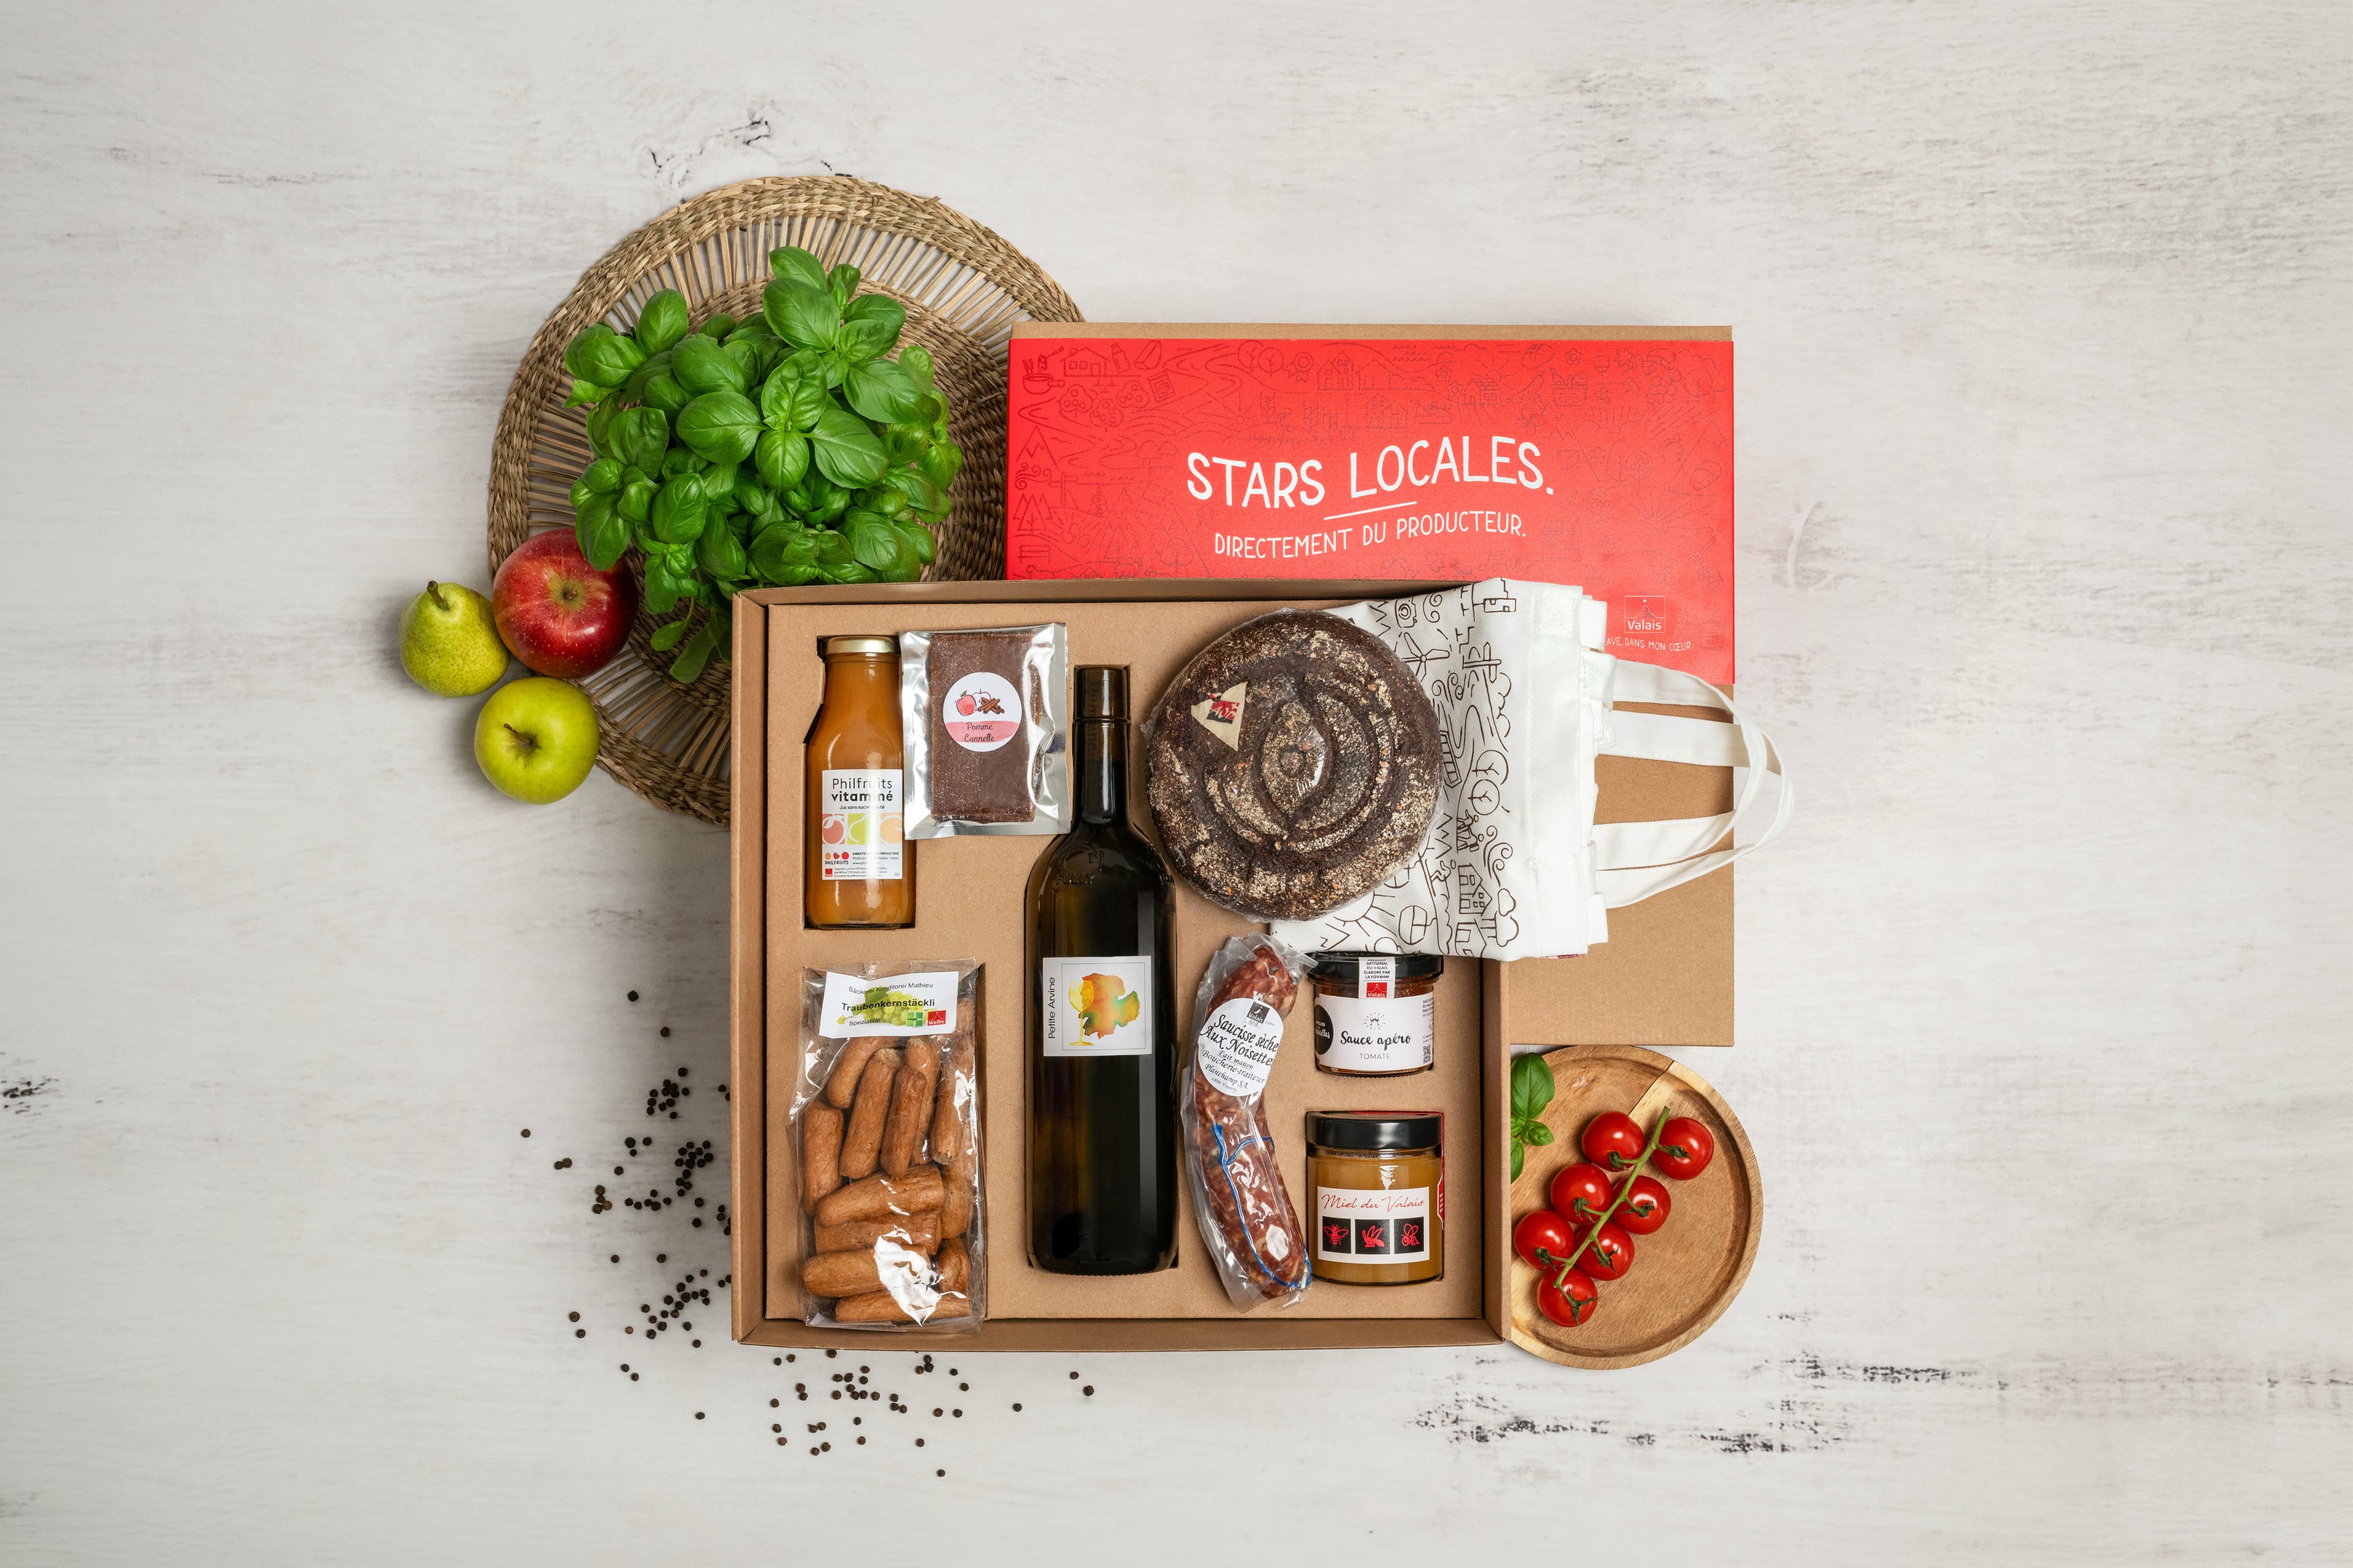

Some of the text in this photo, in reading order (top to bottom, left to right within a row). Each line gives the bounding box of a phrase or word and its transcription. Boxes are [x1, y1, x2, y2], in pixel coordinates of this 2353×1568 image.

[1187, 436, 1553, 509] STARS LOCALES.
[1214, 510, 1526, 559] DIRECTEMENT DU PRODUCTEUR.
[1627, 619, 1662, 630] Valais
[1604, 635, 1621, 646] AVÉ
[1624, 637, 1645, 648] DANS
[1648, 642, 1665, 651] MON
[966, 722, 993, 730] Pomme
[964, 733, 995, 742] Cannelle
[831, 790, 893, 801] vitamné
[849, 986, 875, 994] Bäckerei
[876, 983, 907, 992] Konditorei
[841, 999, 936, 1012] Traubenkernstäckli
[1249, 1012, 1264, 1023] Valais
[1214, 1014, 1279, 1052] Saucisse sèche
[1340, 1031, 1373, 1045] Sauce
[1377, 1033, 1412, 1051] apéro
[1200, 1025, 1273, 1067] Aux Noisette
[1219, 1050, 1254, 1070] Fait maison
[1205, 1063, 1238, 1086] Planchamp
[1322, 1194, 1357, 1210] Miel
[1360, 1199, 1380, 1209] du
[1381, 1195, 1425, 1211] Valais
